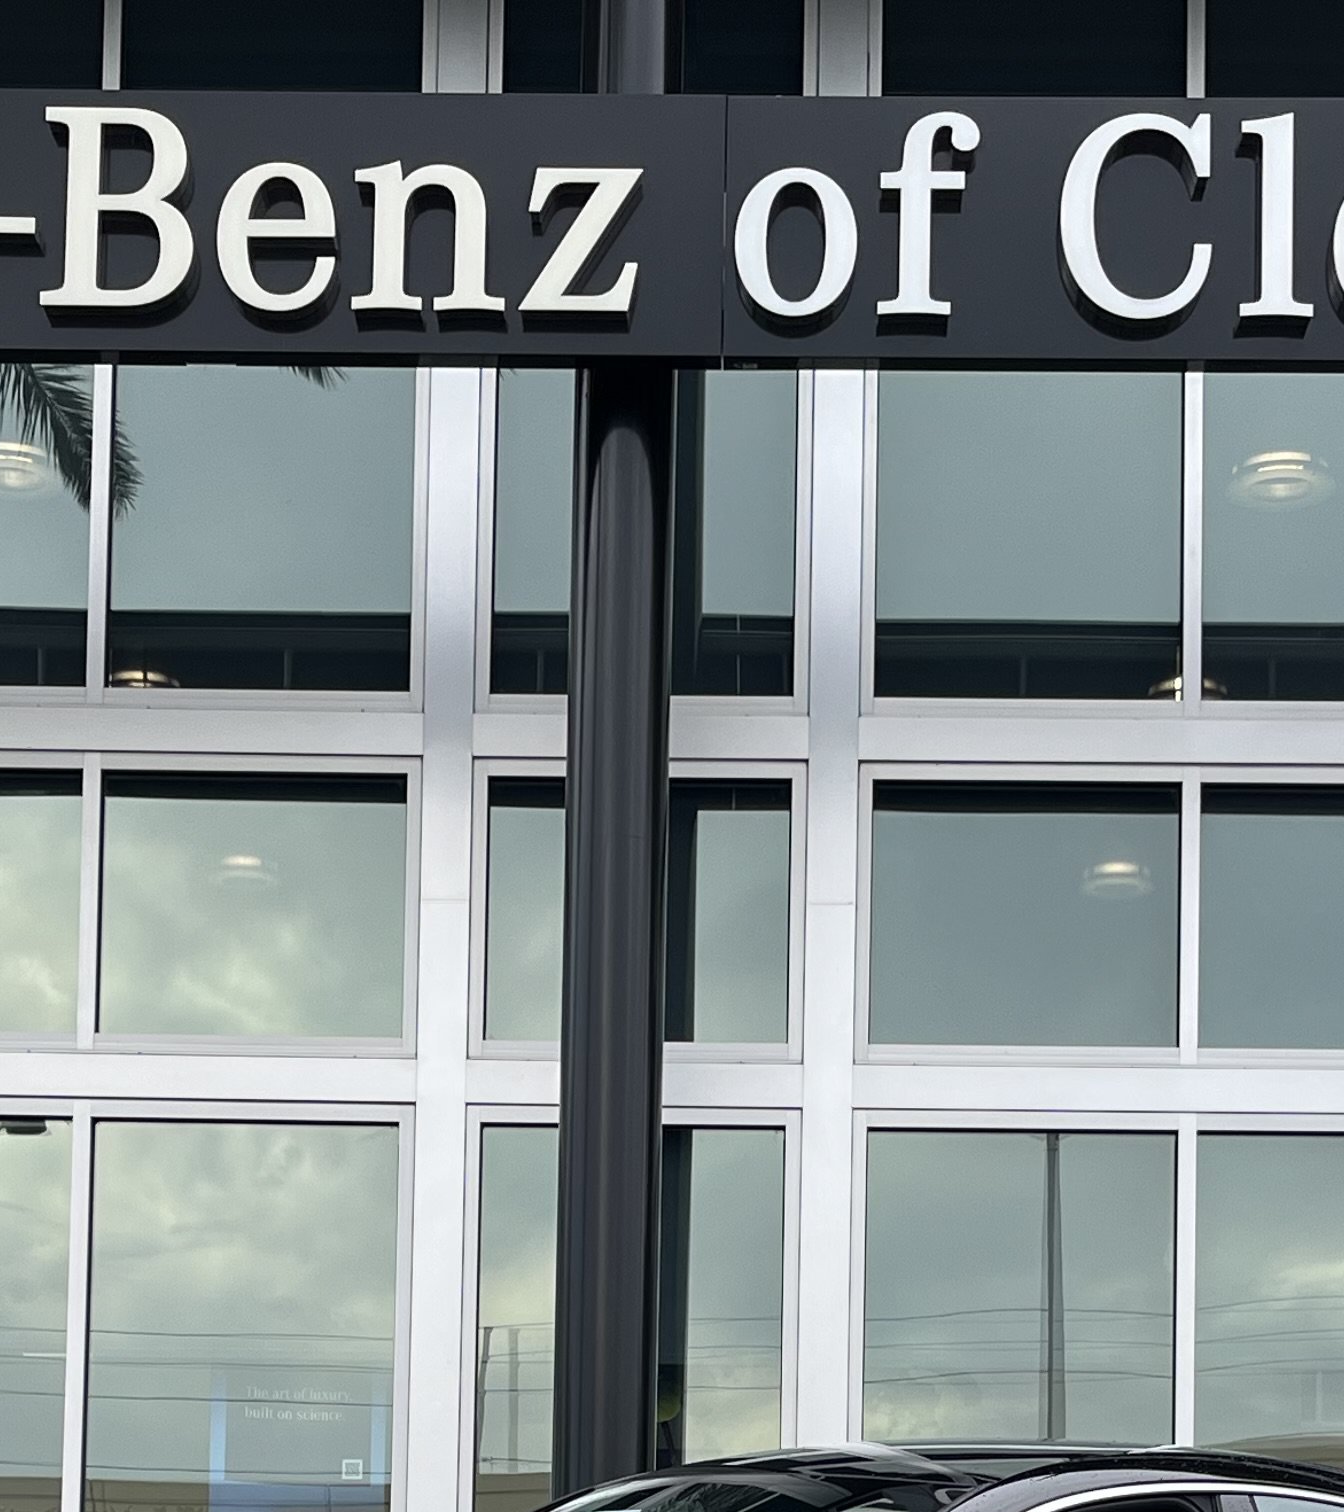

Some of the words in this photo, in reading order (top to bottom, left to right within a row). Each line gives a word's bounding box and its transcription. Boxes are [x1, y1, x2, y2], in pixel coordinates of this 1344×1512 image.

[733, 110, 982, 318] of
[272, 1389, 290, 1400] art
[243, 1406, 274, 1420] built
[276, 1409, 293, 1420] on
